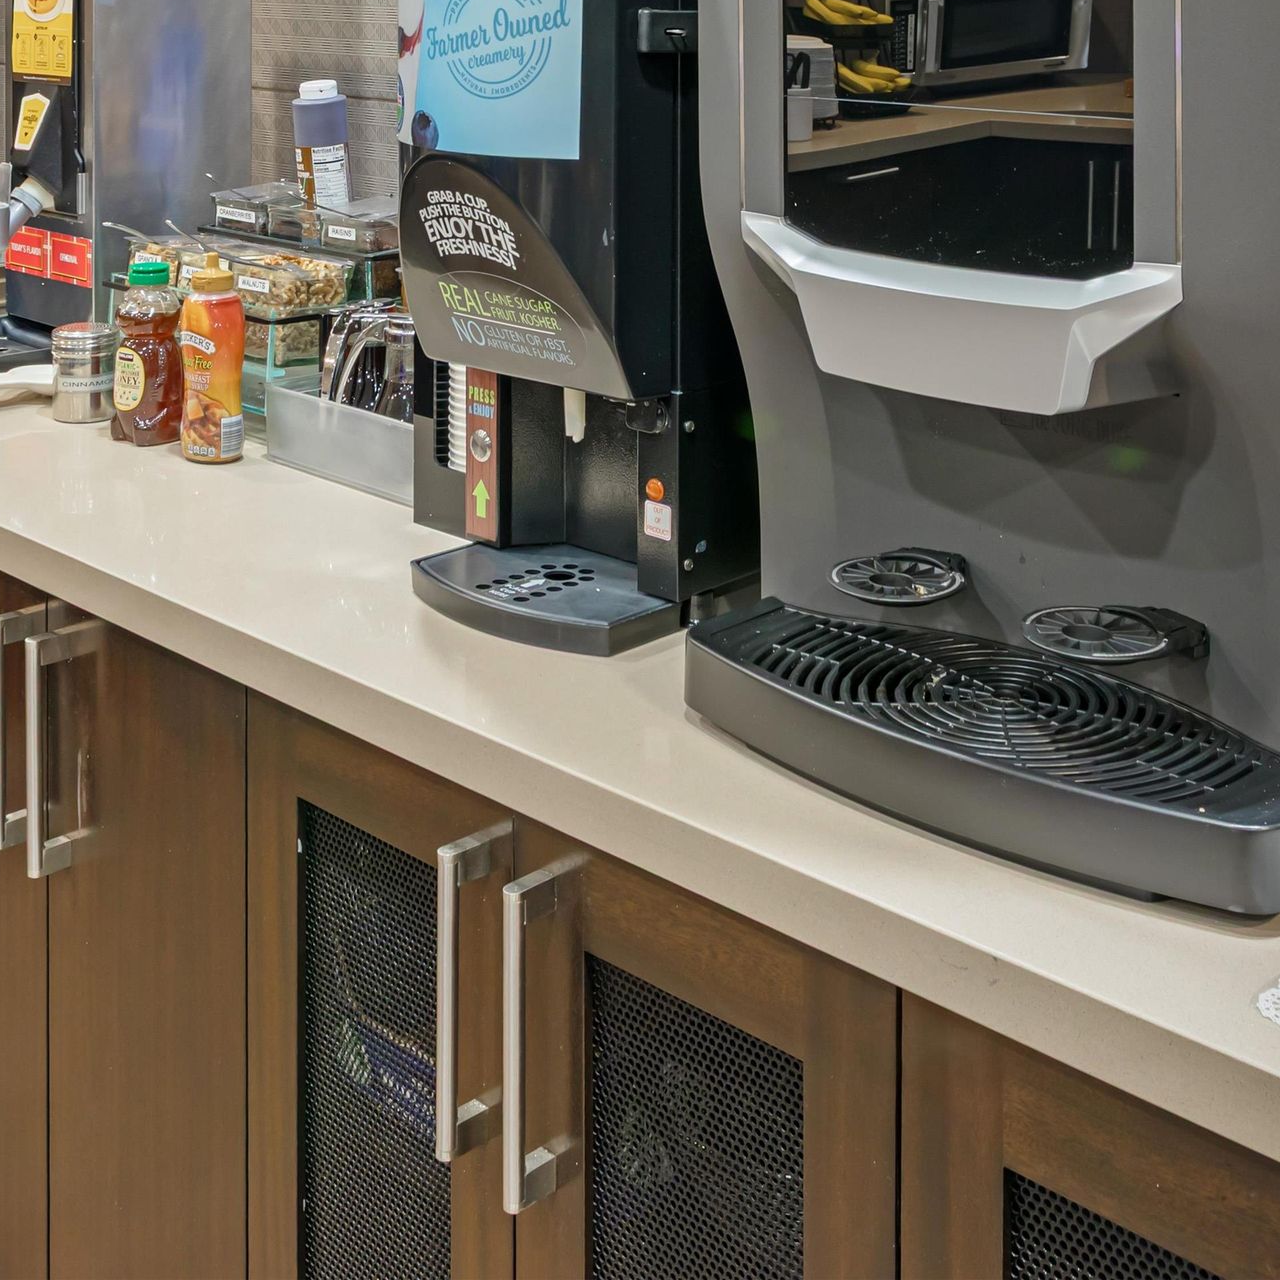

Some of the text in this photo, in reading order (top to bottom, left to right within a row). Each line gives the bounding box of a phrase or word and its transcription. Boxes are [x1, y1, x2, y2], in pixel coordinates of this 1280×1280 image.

[426, 24, 490, 60] Farmer
[468, 45, 526, 70] creamery
[460, 66, 536, 95] NATURAL INGREDIENTS
[427, 190, 490, 212] GRAB A CUP.
[219, 208, 252, 220] CRANBERRIES
[419, 204, 514, 236] PUSH THE BUTTON.
[332, 227, 352, 238] RAISINS
[424, 216, 520, 258] ENJOY THE
[10, 242, 42, 257] TODAY'S FLAVOR
[436, 238, 517, 271] FRESHNESS!
[241, 278, 266, 290] WALNUTS
[438, 281, 557, 317] REAL CANE SUGAR.
[451, 316, 486, 346] NO
[484, 324, 526, 343] GLUTEN
[526, 333, 542, 346] OR
[490, 306, 562, 332] FRUIT. KOSHER.
[194, 355, 213, 370] Free
[487, 338, 576, 366] ARTIFICIAL FLAVORS.
[468, 385, 495, 406] PRESS
[473, 402, 495, 420] ENJOY
